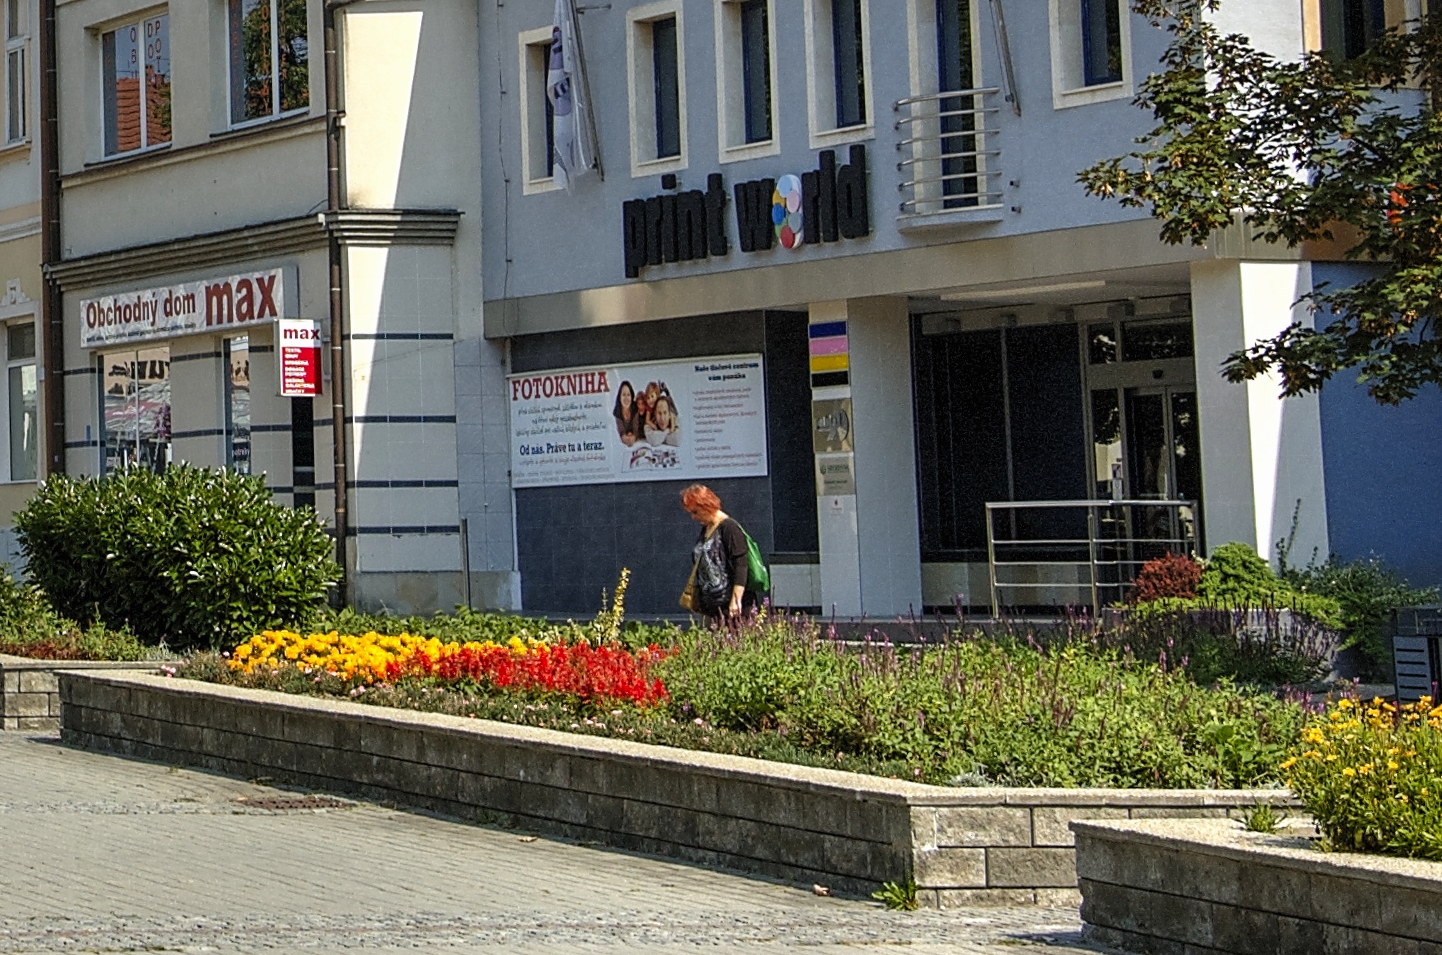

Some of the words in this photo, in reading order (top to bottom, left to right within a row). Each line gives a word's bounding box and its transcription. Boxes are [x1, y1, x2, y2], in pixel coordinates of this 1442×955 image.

[623, 174, 728, 278] print
[734, 144, 870, 252] world
[86, 292, 158, 328] Obchodný
[163, 290, 196, 318] dom
[205, 275, 278, 326] max
[283, 328, 320, 340] max
[511, 371, 610, 401] FOTOKNIHA
[519, 444, 530, 456] Od
[546, 442, 567, 454] Práve
